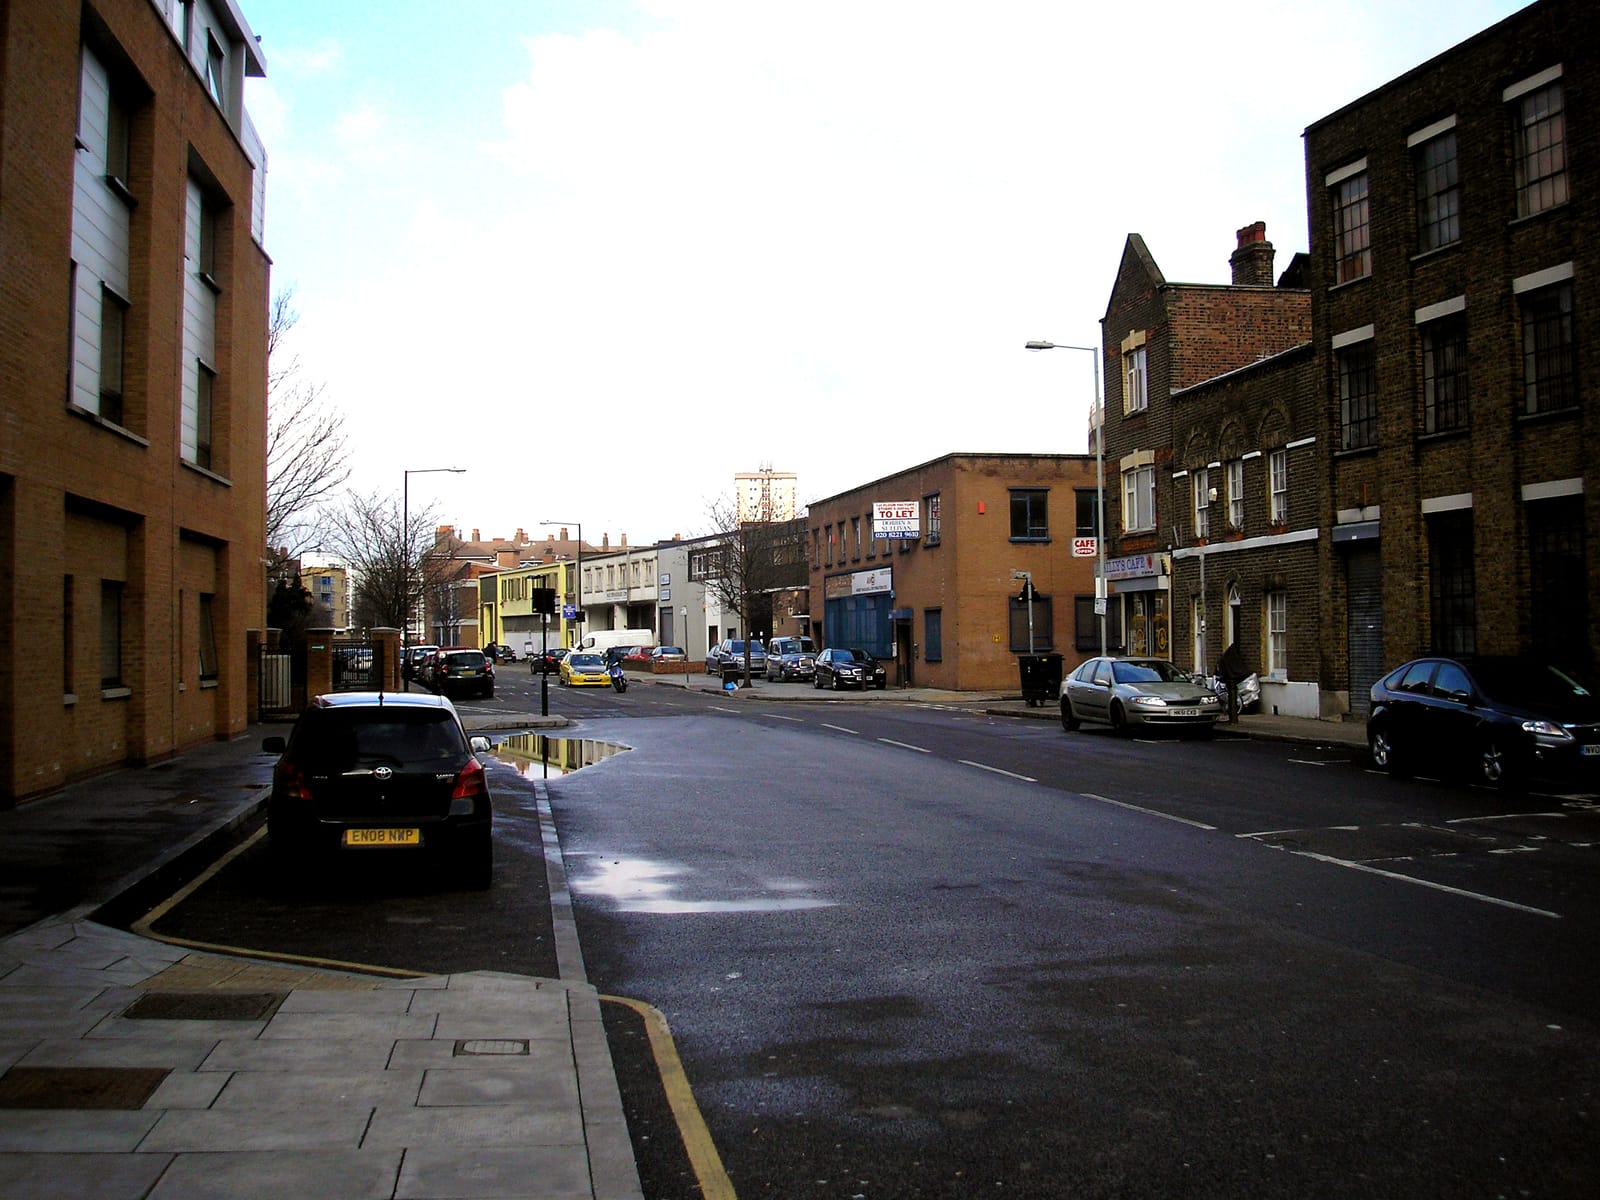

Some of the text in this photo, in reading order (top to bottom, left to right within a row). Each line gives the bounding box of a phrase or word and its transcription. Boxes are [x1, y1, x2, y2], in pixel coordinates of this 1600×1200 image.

[879, 510, 914, 518] TO LET
[1074, 539, 1095, 548] CAFE
[1126, 556, 1145, 570] CAFE
[352, 829, 414, 842] EN08 NWP
